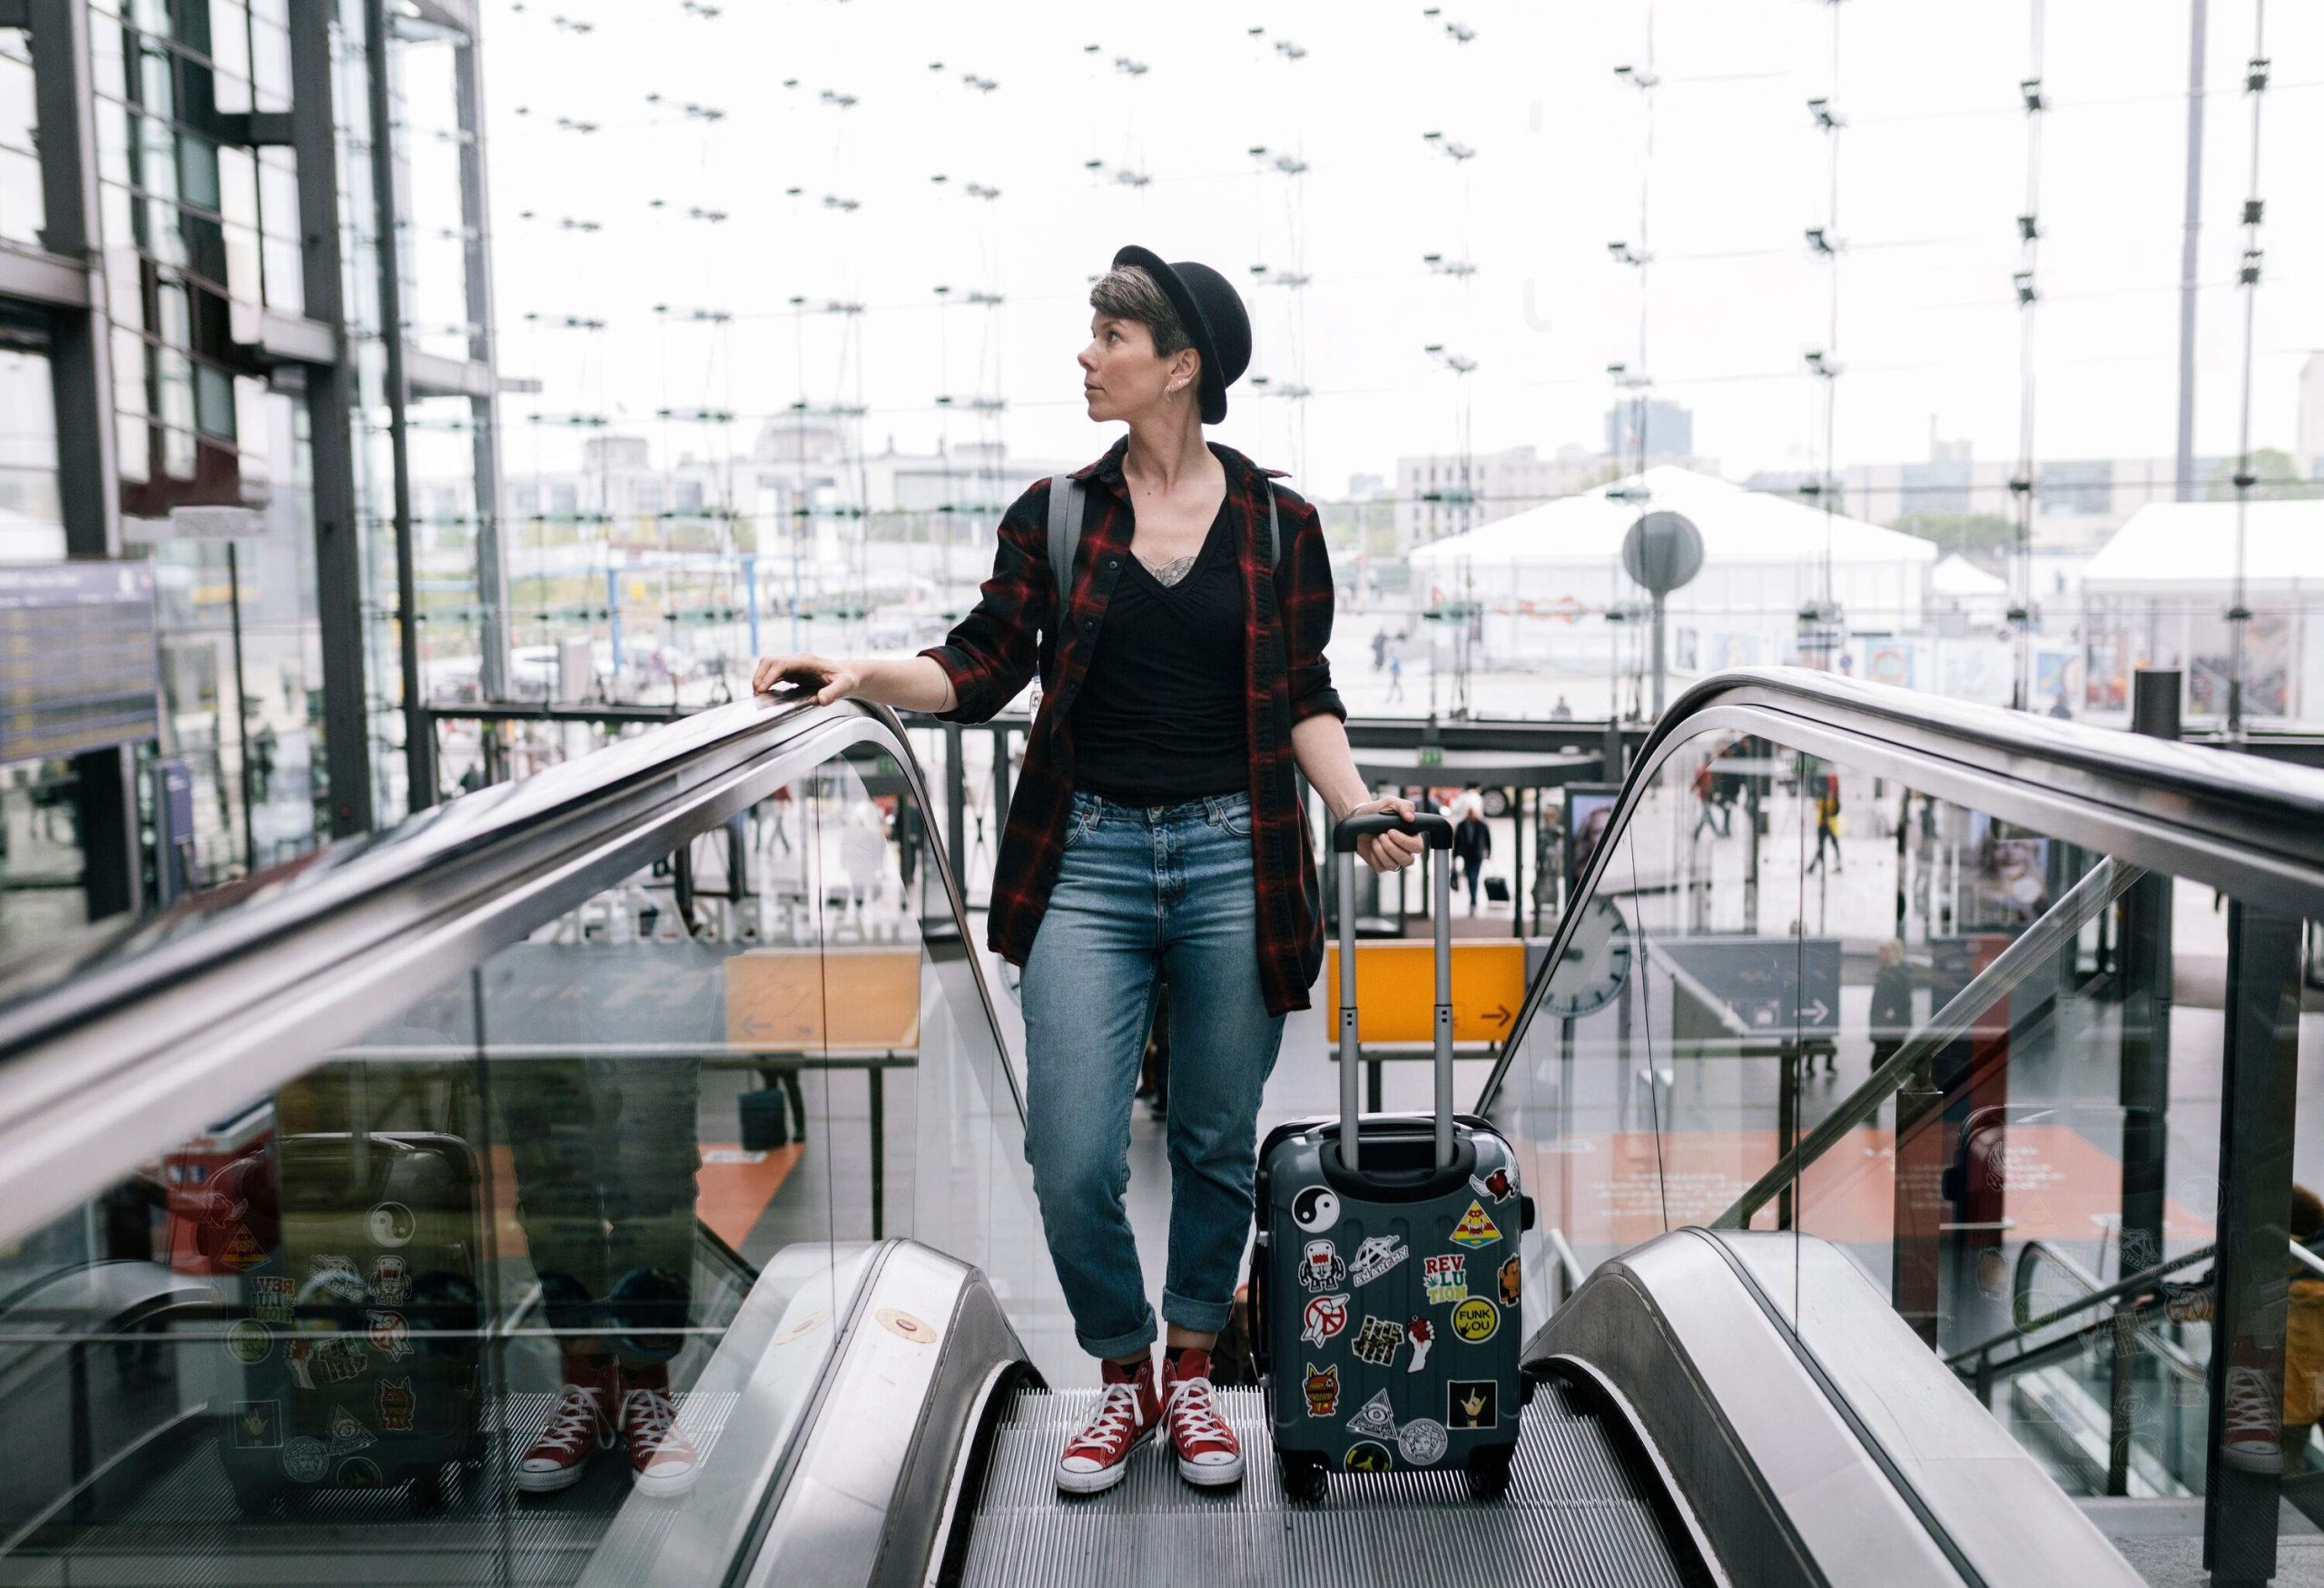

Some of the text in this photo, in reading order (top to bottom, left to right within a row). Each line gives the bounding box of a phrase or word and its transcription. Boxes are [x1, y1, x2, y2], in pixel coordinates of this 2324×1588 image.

[1355, 1248, 1407, 1285] ANARCHY
[1426, 1256, 1463, 1274] REV
[1428, 1287, 1467, 1304] TION
[1460, 1309, 1490, 1320] FUNK
